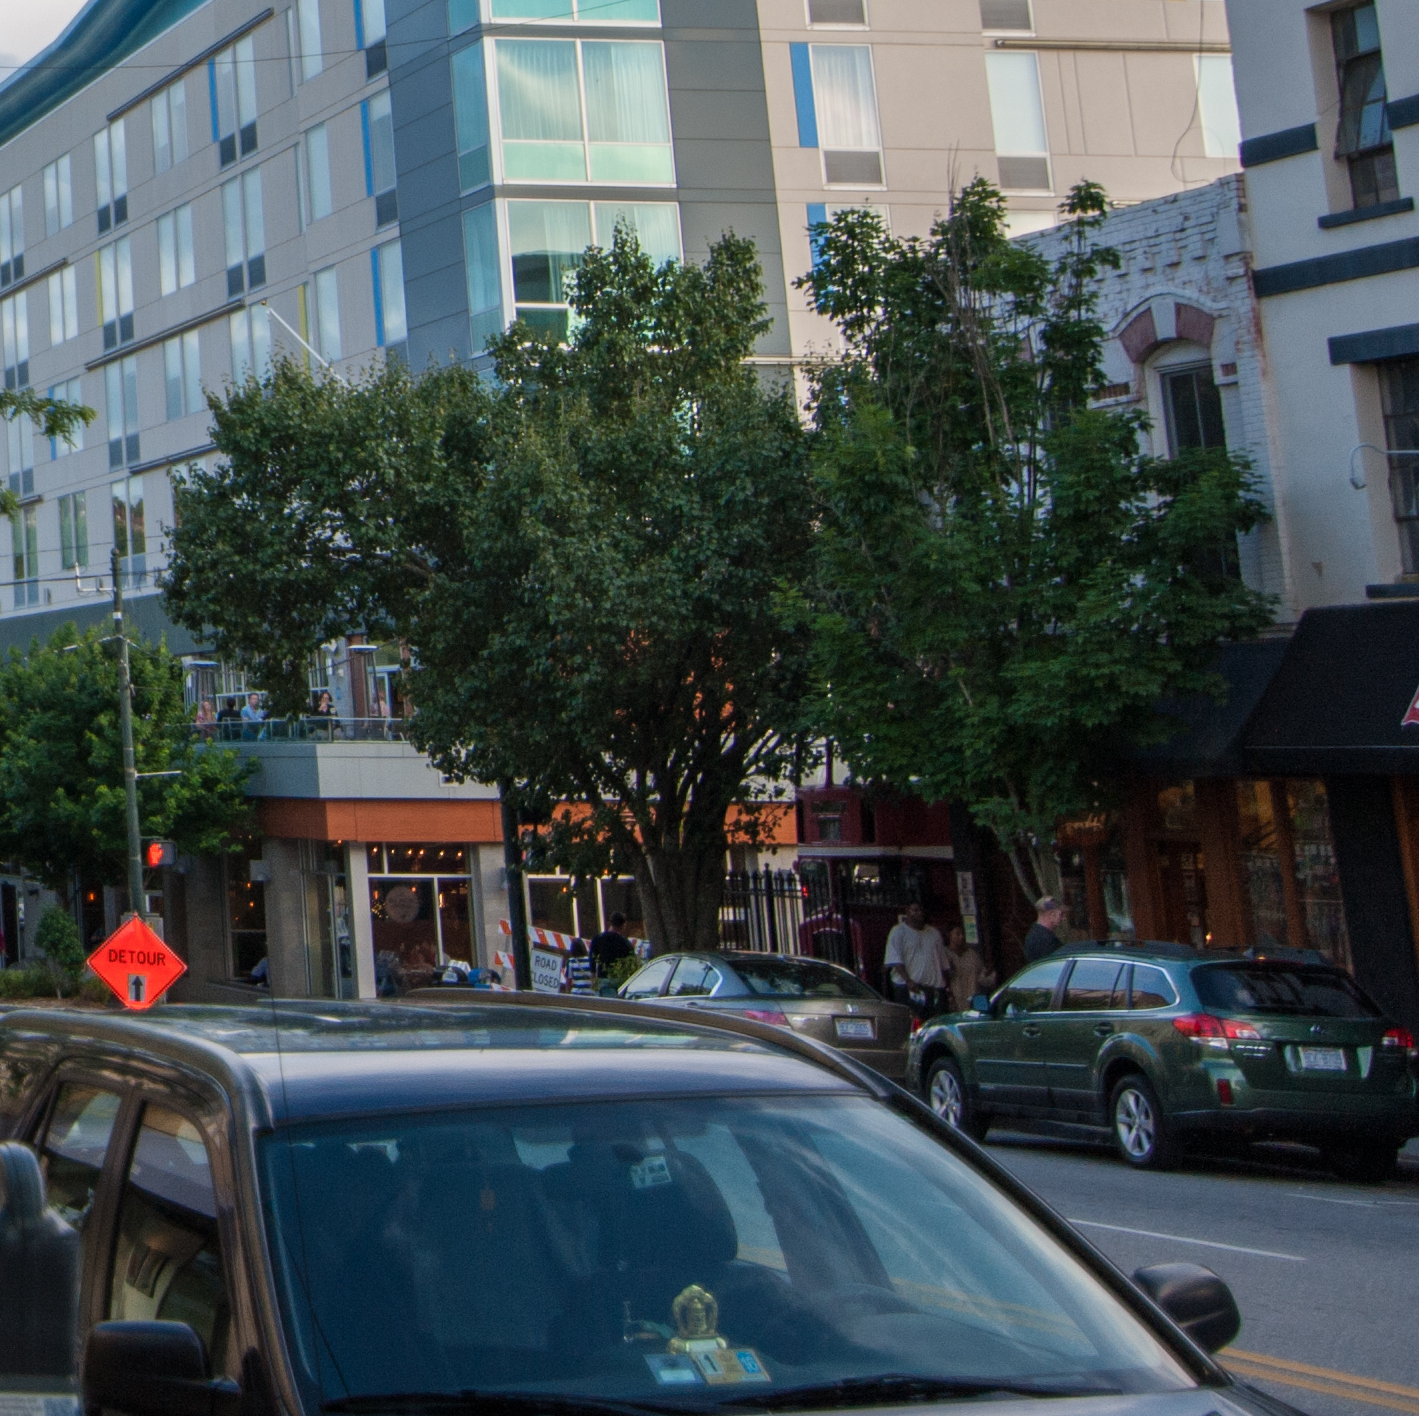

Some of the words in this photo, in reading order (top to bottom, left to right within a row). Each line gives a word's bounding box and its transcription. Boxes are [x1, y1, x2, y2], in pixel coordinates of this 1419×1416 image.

[108, 949, 166, 966] DETOUR
[534, 955, 557, 971] ROAD
[532, 972, 560, 989] LOSED
